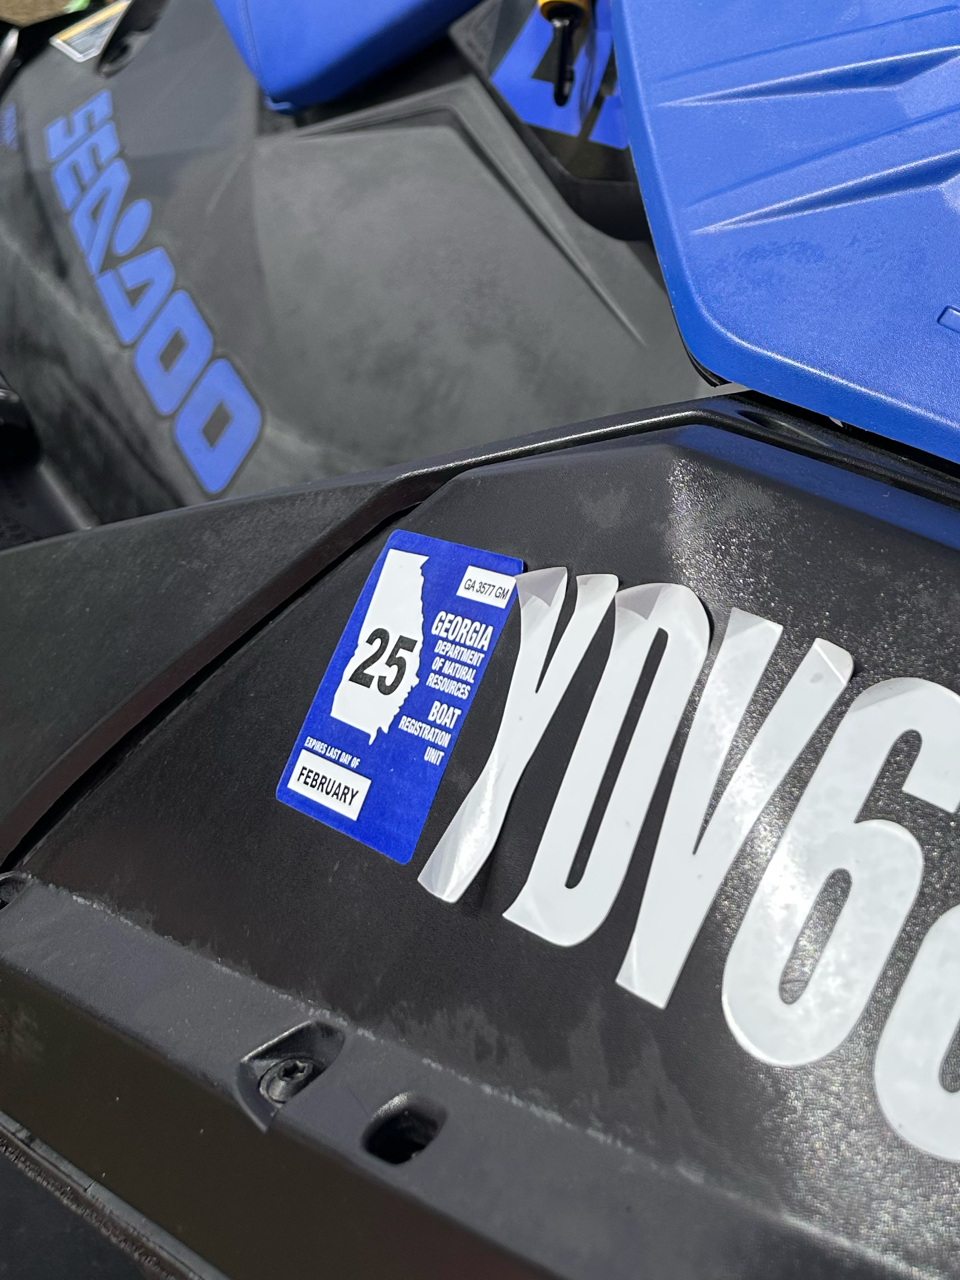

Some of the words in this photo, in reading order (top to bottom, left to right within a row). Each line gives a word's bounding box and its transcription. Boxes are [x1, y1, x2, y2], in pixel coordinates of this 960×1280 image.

[464, 578, 477, 592] GA
[475, 581, 497, 597] 3577
[494, 586, 510, 601] GM
[430, 610, 494, 651] GEORGIA
[348, 627, 418, 696] 25
[433, 639, 486, 667] DEPARTMENT
[431, 656, 446, 672] OF
[441, 659, 477, 684] NATURAL
[425, 672, 472, 700] RESOURCES
[427, 700, 462, 729] BOAT
[398, 715, 452, 748] REGISTRATION
[303, 736, 328, 755] EXPIRES
[325, 745, 342, 761] LAST
[339, 751, 353, 766] DAY
[350, 756, 361, 769] OF
[423, 746, 445, 766] UNIT
[297, 766, 360, 806] FEBRUARY
